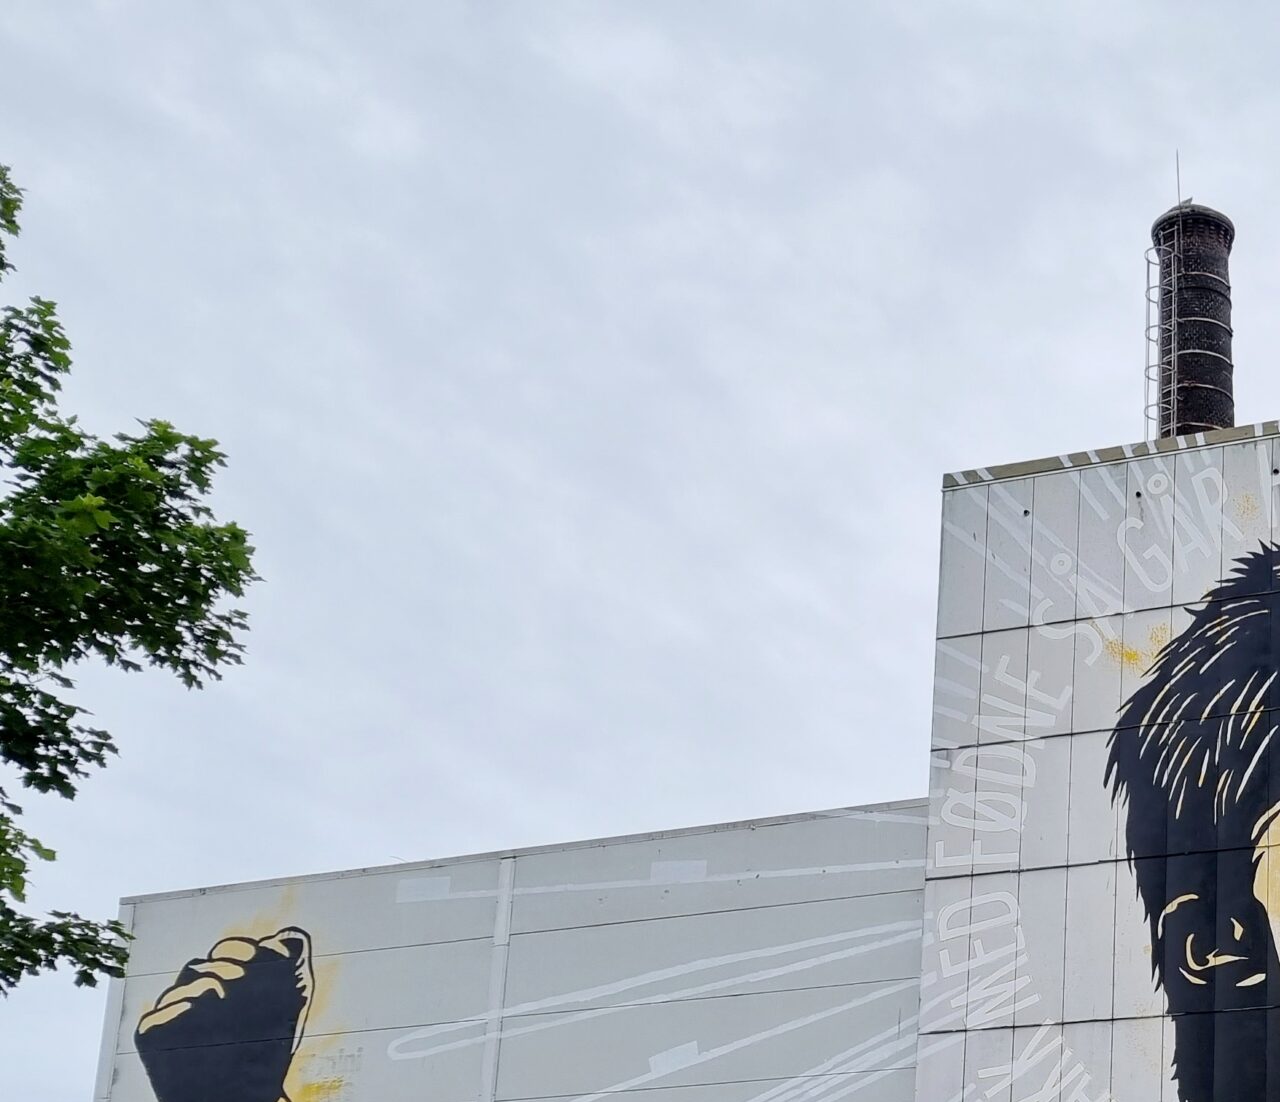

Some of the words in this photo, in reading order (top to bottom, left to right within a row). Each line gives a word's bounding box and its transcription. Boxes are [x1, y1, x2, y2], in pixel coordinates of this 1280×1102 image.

[1115, 467, 1244, 594] GÅR
[1034, 552, 1133, 668] SÅ
[934, 654, 1073, 869] FØDNE
[938, 890, 1041, 1031] MED
